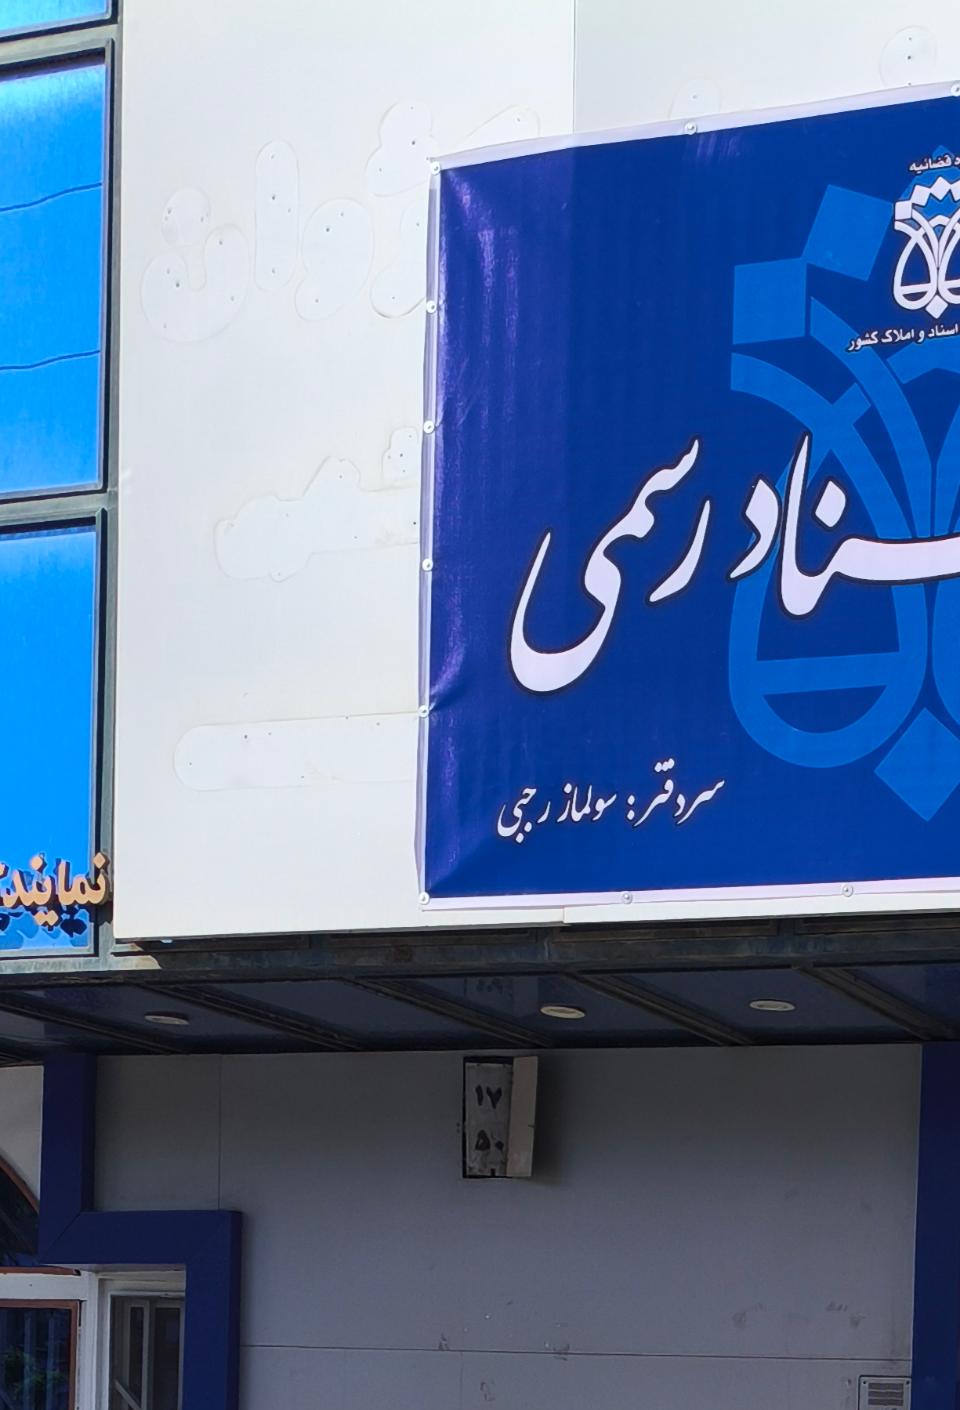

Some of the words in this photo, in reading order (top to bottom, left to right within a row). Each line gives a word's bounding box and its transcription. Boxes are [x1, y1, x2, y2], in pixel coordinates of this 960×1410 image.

[847, 330, 879, 351] کشور
[880, 328, 915, 344] املاک
[917, 330, 925, 343] و
[927, 323, 959, 338] اسناد
[508, 437, 713, 694] رسمی
[556, 782, 618, 823] سولماز
[496, 787, 551, 844] رجبی
